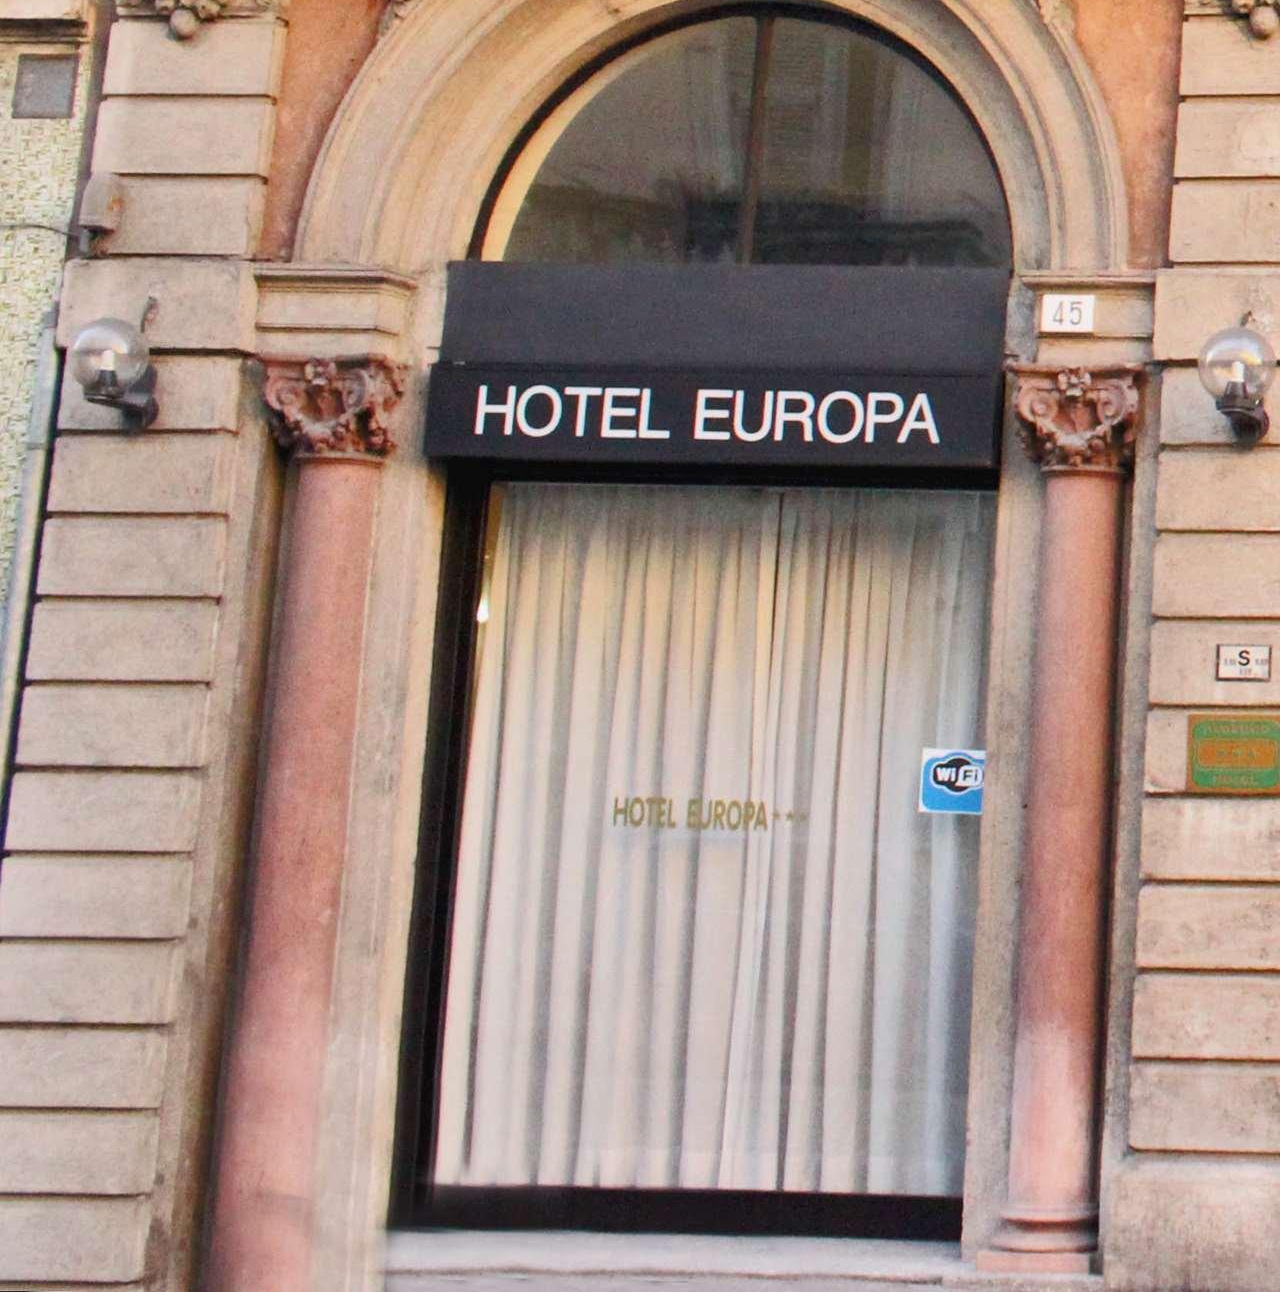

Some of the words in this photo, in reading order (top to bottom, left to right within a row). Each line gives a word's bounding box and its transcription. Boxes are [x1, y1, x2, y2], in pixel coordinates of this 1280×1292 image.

[1052, 300, 1082, 325] 45
[474, 384, 670, 439] HOTEL
[693, 388, 940, 444] EUROPA
[1238, 649, 1251, 667] S
[612, 796, 677, 829] HOTEL
[686, 797, 768, 832] EUROPA
